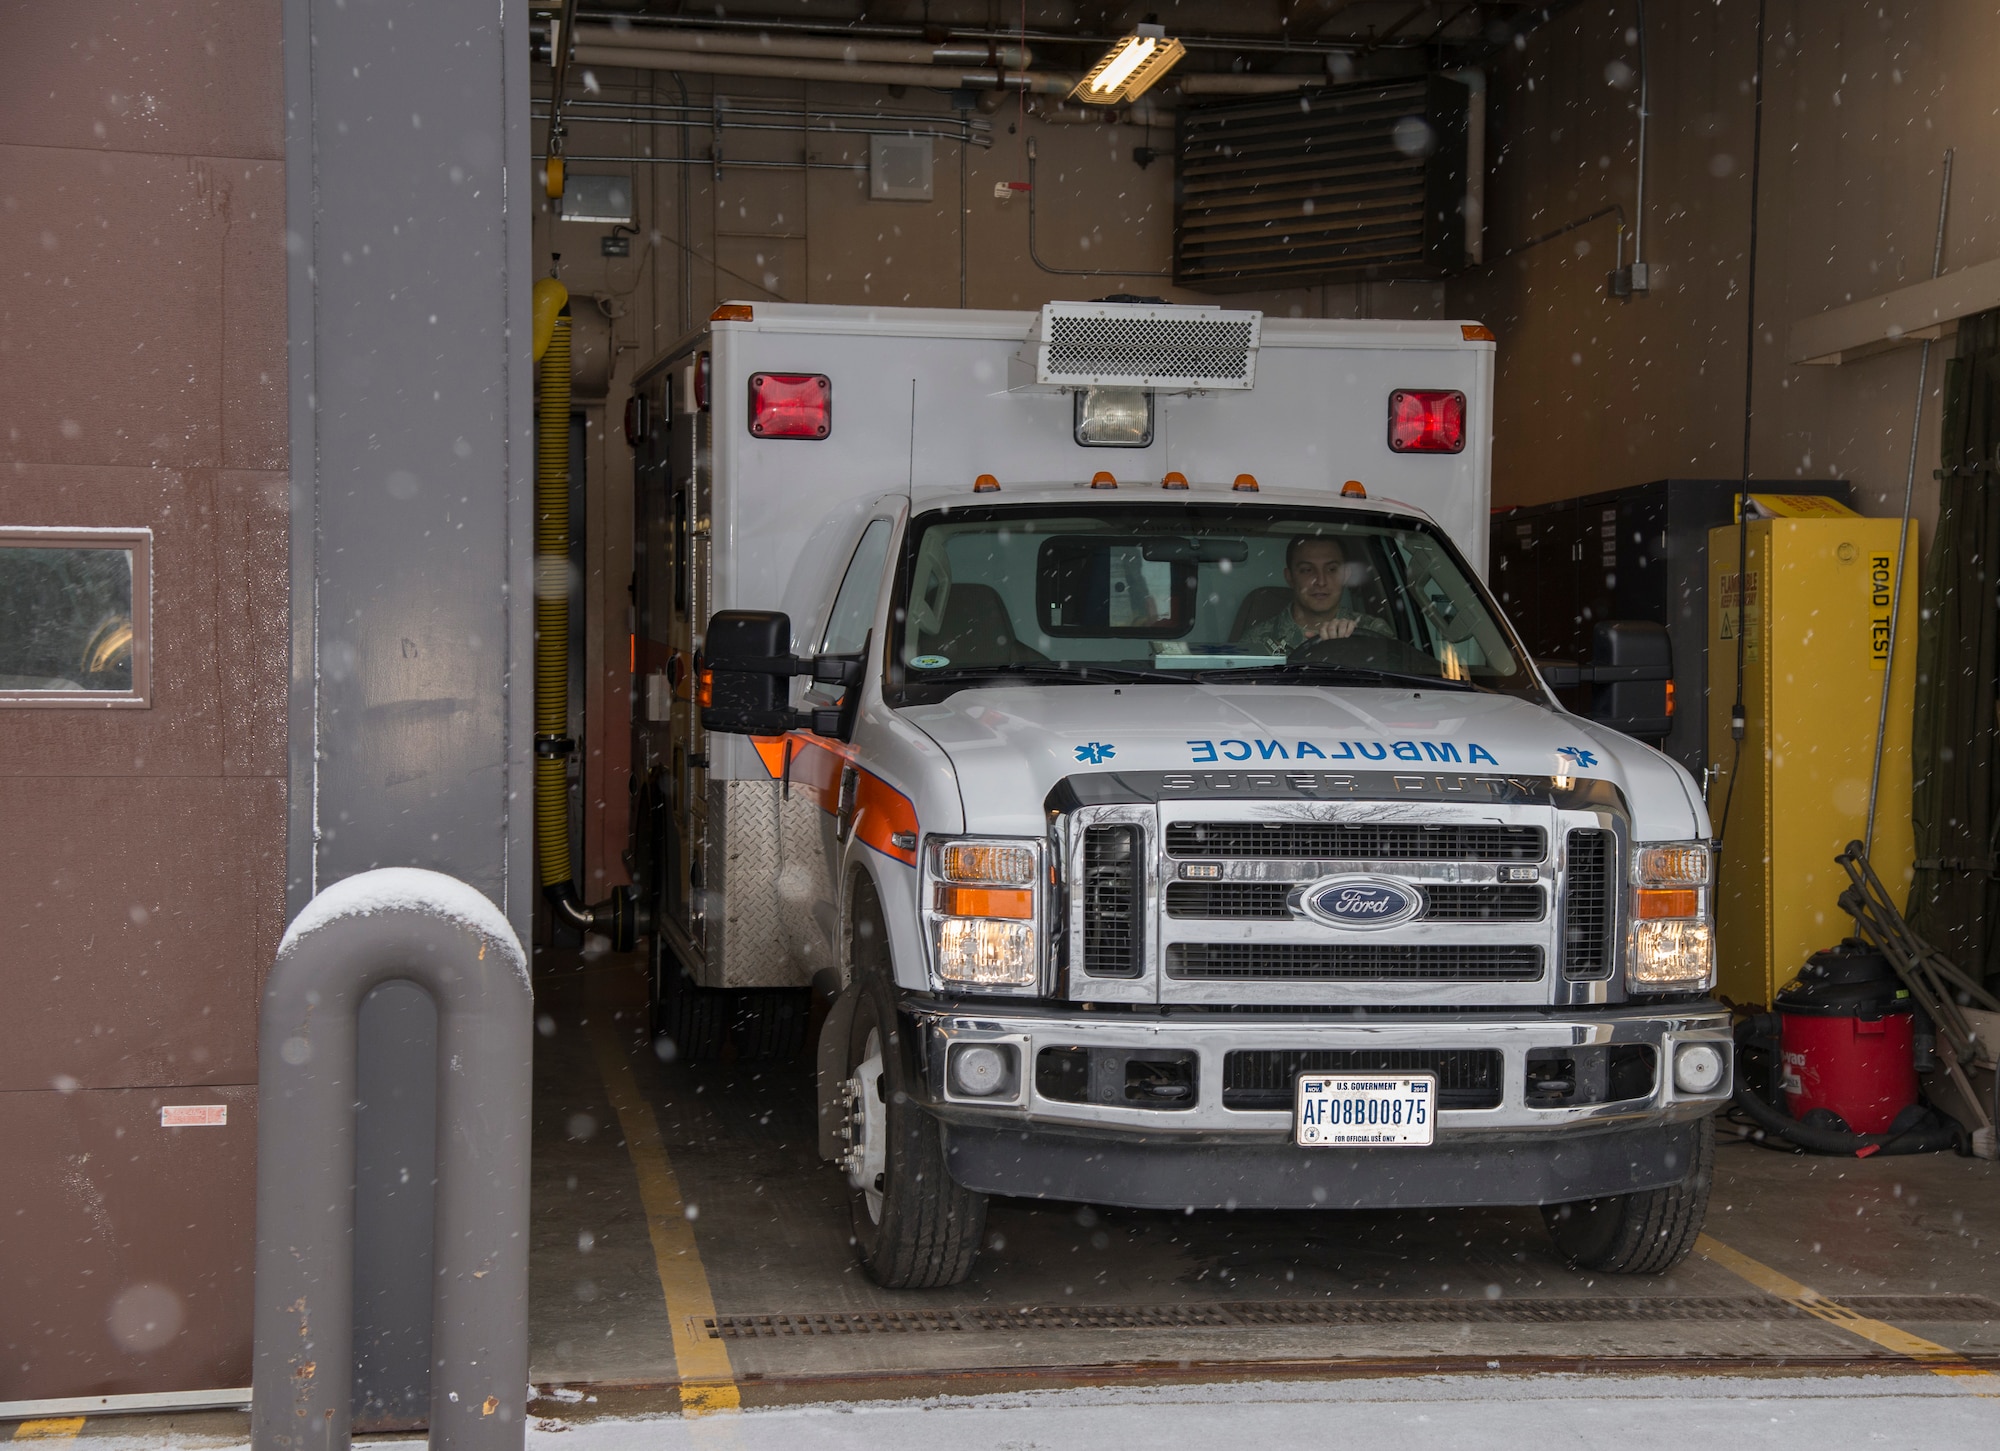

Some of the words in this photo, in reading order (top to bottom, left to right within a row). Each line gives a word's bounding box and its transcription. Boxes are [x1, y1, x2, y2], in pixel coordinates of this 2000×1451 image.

[1872, 557, 1890, 606] ROAD
[1161, 773, 1359, 792] SUPER
[1392, 775, 1542, 796] DUTY
[1335, 889, 1391, 913] Ford
[1336, 1082, 1350, 1091] U.S.
[1350, 1082, 1398, 1091] GOVERNMENT
[1303, 1099, 1426, 1125] AF08B00875
[1334, 1135, 1346, 1143] FOR
[1346, 1135, 1370, 1143] OFFICIAL
[1371, 1135, 1382, 1143] USE
[1382, 1135, 1396, 1143] ONLY
